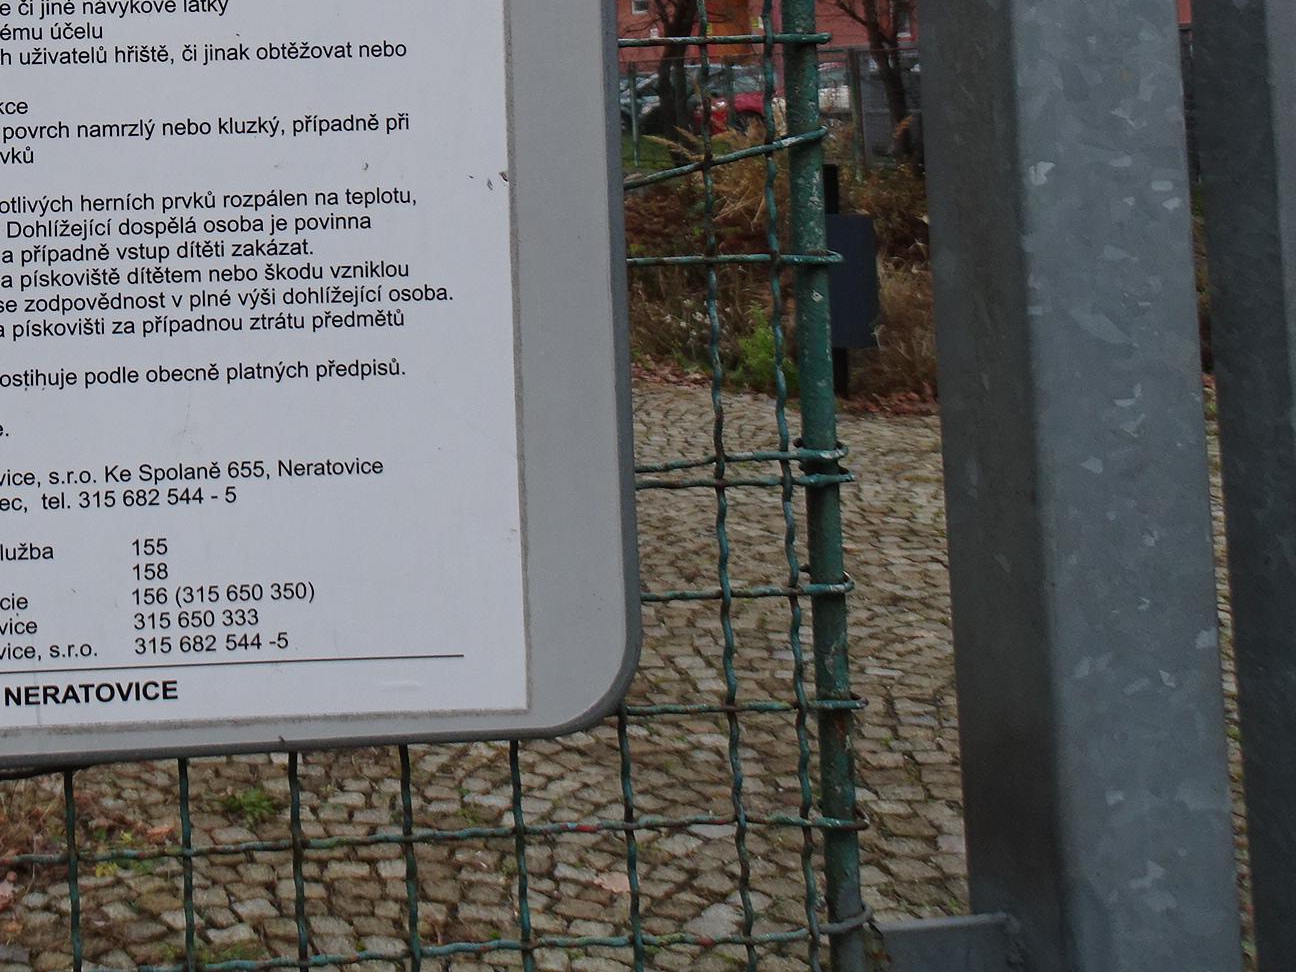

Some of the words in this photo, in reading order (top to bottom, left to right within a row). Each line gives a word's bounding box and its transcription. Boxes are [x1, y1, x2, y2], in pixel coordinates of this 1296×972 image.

[1, 249, 14, 264] a
[21, 242, 110, 267] případně
[116, 242, 170, 264] vstup
[176, 239, 225, 259] dítěti
[231, 238, 314, 257] zakázat.
[48, 470, 97, 485] s.r.o.
[104, 465, 132, 483] Ke
[138, 461, 221, 486] Spolaně
[227, 460, 270, 481] 655,
[278, 457, 384, 477] Neratovice
[40, 491, 71, 510] tel.
[78, 490, 116, 509] 315
[122, 488, 161, 507] 682
[167, 486, 204, 506] 544
[225, 485, 237, 504] 5
[131, 537, 168, 557] 155
[132, 562, 169, 581] 158
[131, 587, 168, 606] 156
[175, 585, 220, 609] (315
[226, 583, 264, 602] 650
[270, 581, 315, 604] 350)
[4, 680, 179, 707] NERATOVICE
